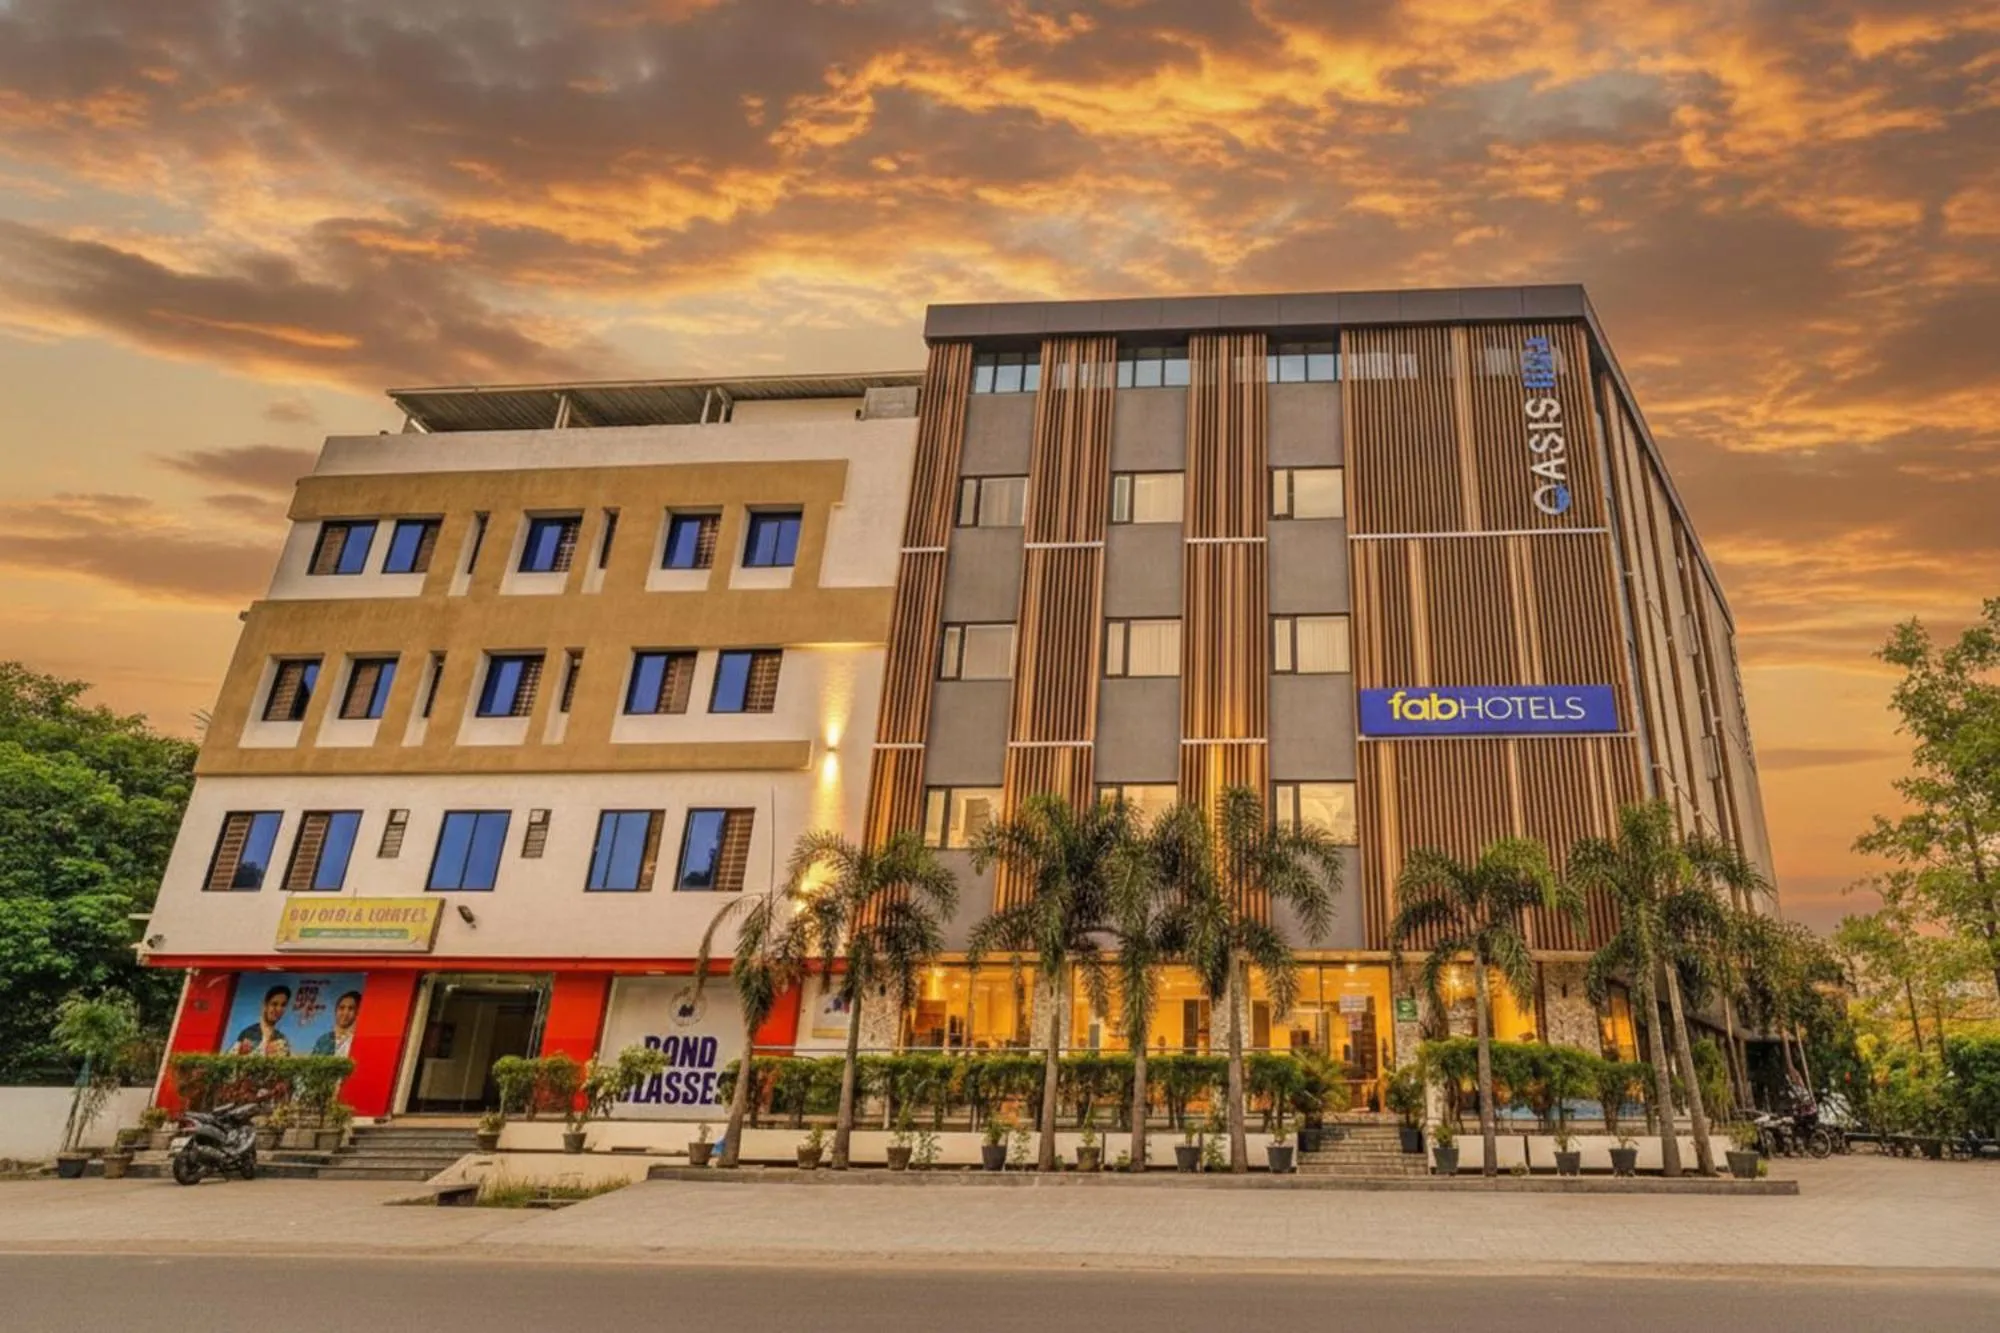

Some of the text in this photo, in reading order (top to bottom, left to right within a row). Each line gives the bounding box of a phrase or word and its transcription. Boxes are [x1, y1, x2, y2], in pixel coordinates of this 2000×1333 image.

[1525, 398, 1571, 515] OASIS
[1388, 691, 1586, 721] fabHOTELS
[616, 1071, 735, 1105] LASSE
